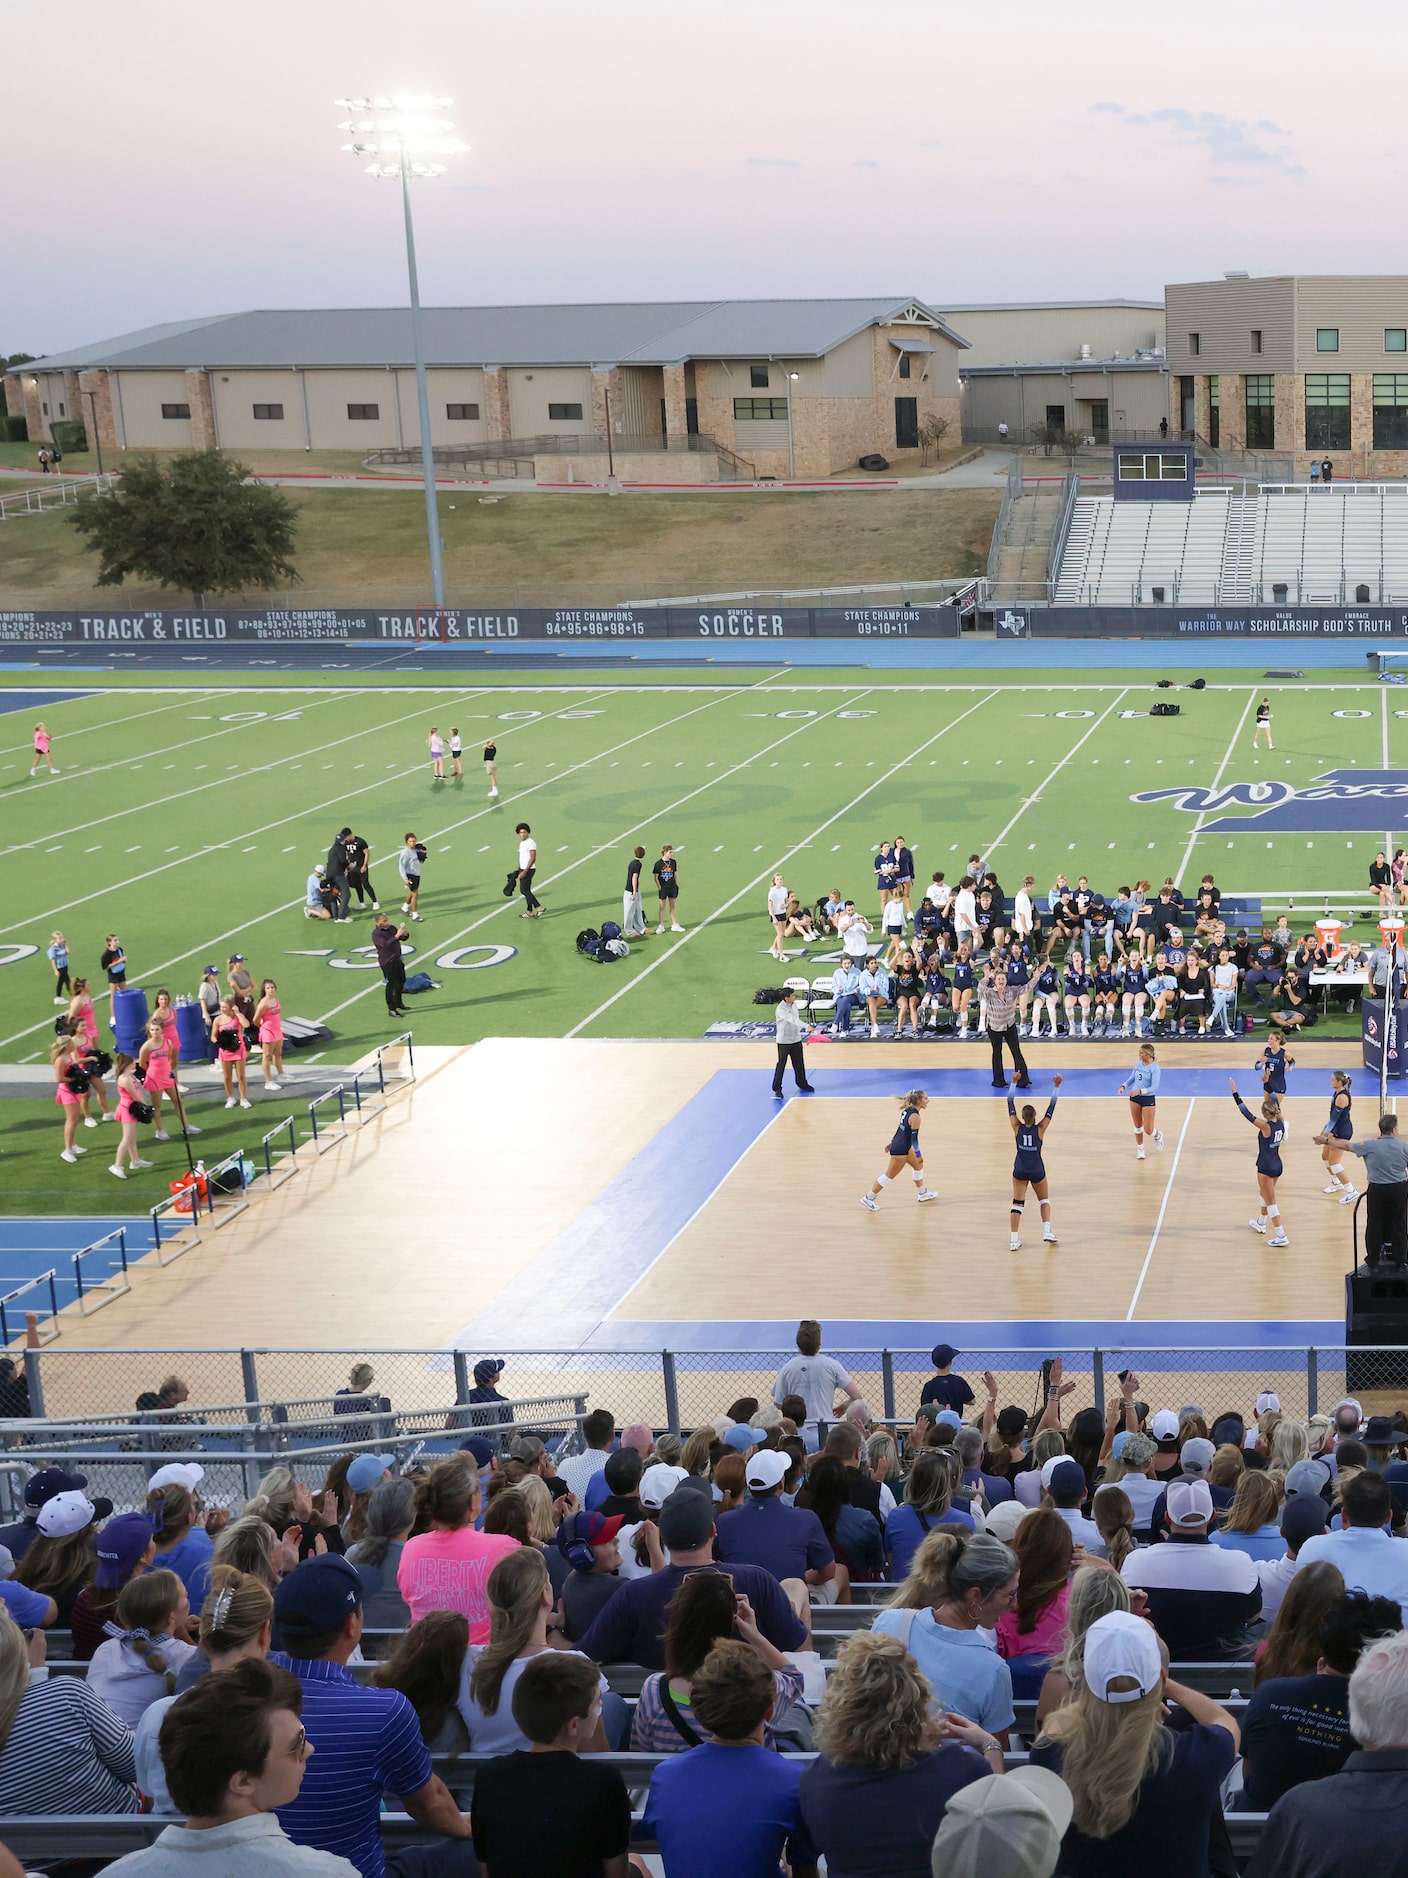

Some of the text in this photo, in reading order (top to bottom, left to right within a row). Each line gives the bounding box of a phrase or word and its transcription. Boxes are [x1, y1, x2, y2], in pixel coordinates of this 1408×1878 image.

[266, 611, 337, 620] STATE CHAMPIONS
[555, 611, 634, 621] STATE CHAMPIONS
[844, 611, 920, 620] STATE CHAMPIONS
[80, 617, 227, 641] TRACK & FIELD
[379, 616, 519, 638] TRACK & FIELD
[699, 615, 784, 636] SOCCER
[1178, 620, 1246, 631] WARRIOR WAY
[1250, 619, 1319, 632] SCHOLARSHIP
[1323, 619, 1392, 632] GOD'S TRUTH
[217, 710, 306, 723] 10
[494, 709, 607, 722] 20
[774, 708, 882, 720] 30
[1268, 1062, 1275, 1072] 5
[1138, 1073, 1143, 1081] 3
[1022, 1134, 1033, 1147] 11
[409, 1556, 488, 1591] LIBERTY
[1279, 1705, 1291, 1713] only
[1292, 1706, 1307, 1717] thing
[1308, 1711, 1339, 1724] necessary
[1281, 1713, 1289, 1721] of
[1305, 1718, 1316, 1726] for
[1316, 1721, 1334, 1731] good
[1334, 1726, 1349, 1734] men
[1297, 1726, 1342, 1743] NOTHING
